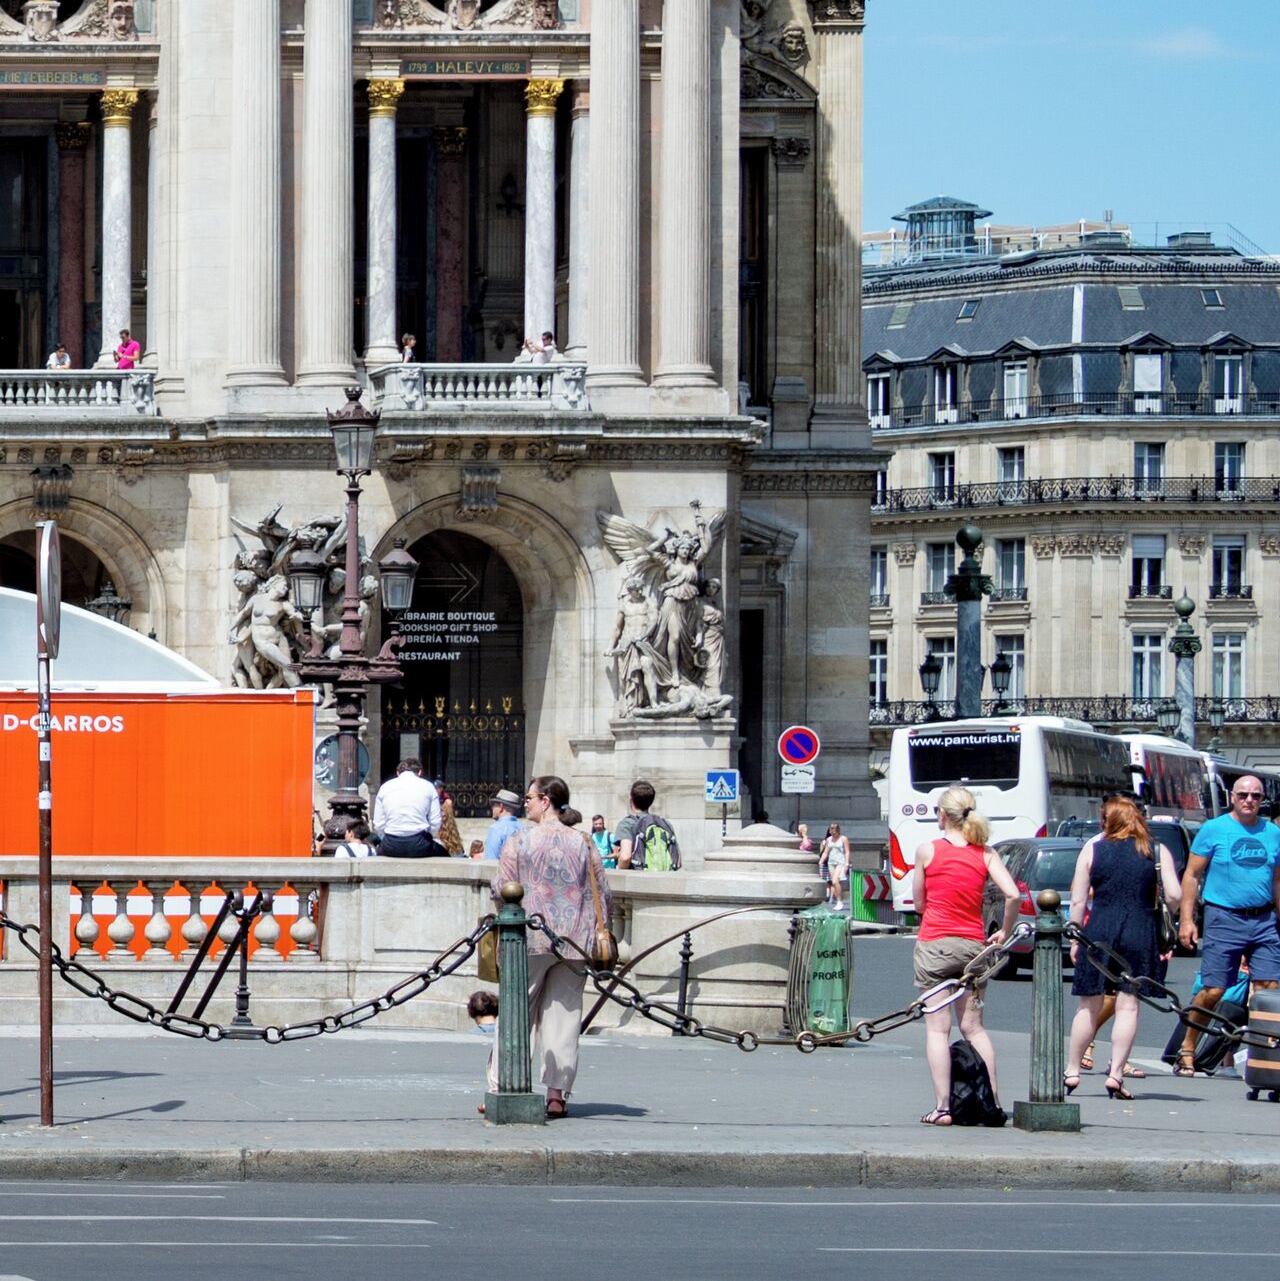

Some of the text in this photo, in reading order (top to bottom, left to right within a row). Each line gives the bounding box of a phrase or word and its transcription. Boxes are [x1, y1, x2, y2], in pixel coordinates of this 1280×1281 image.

[435, 61, 494, 74] HALEVY
[447, 612, 496, 621] BOUTIQUE
[449, 623, 471, 632] GIFT
[472, 623, 498, 632] SHOP
[404, 633, 480, 643] BRERÍA TIENDA
[398, 651, 462, 661] RESTAURANT
[909, 734, 1020, 747] www.panturist.hr
